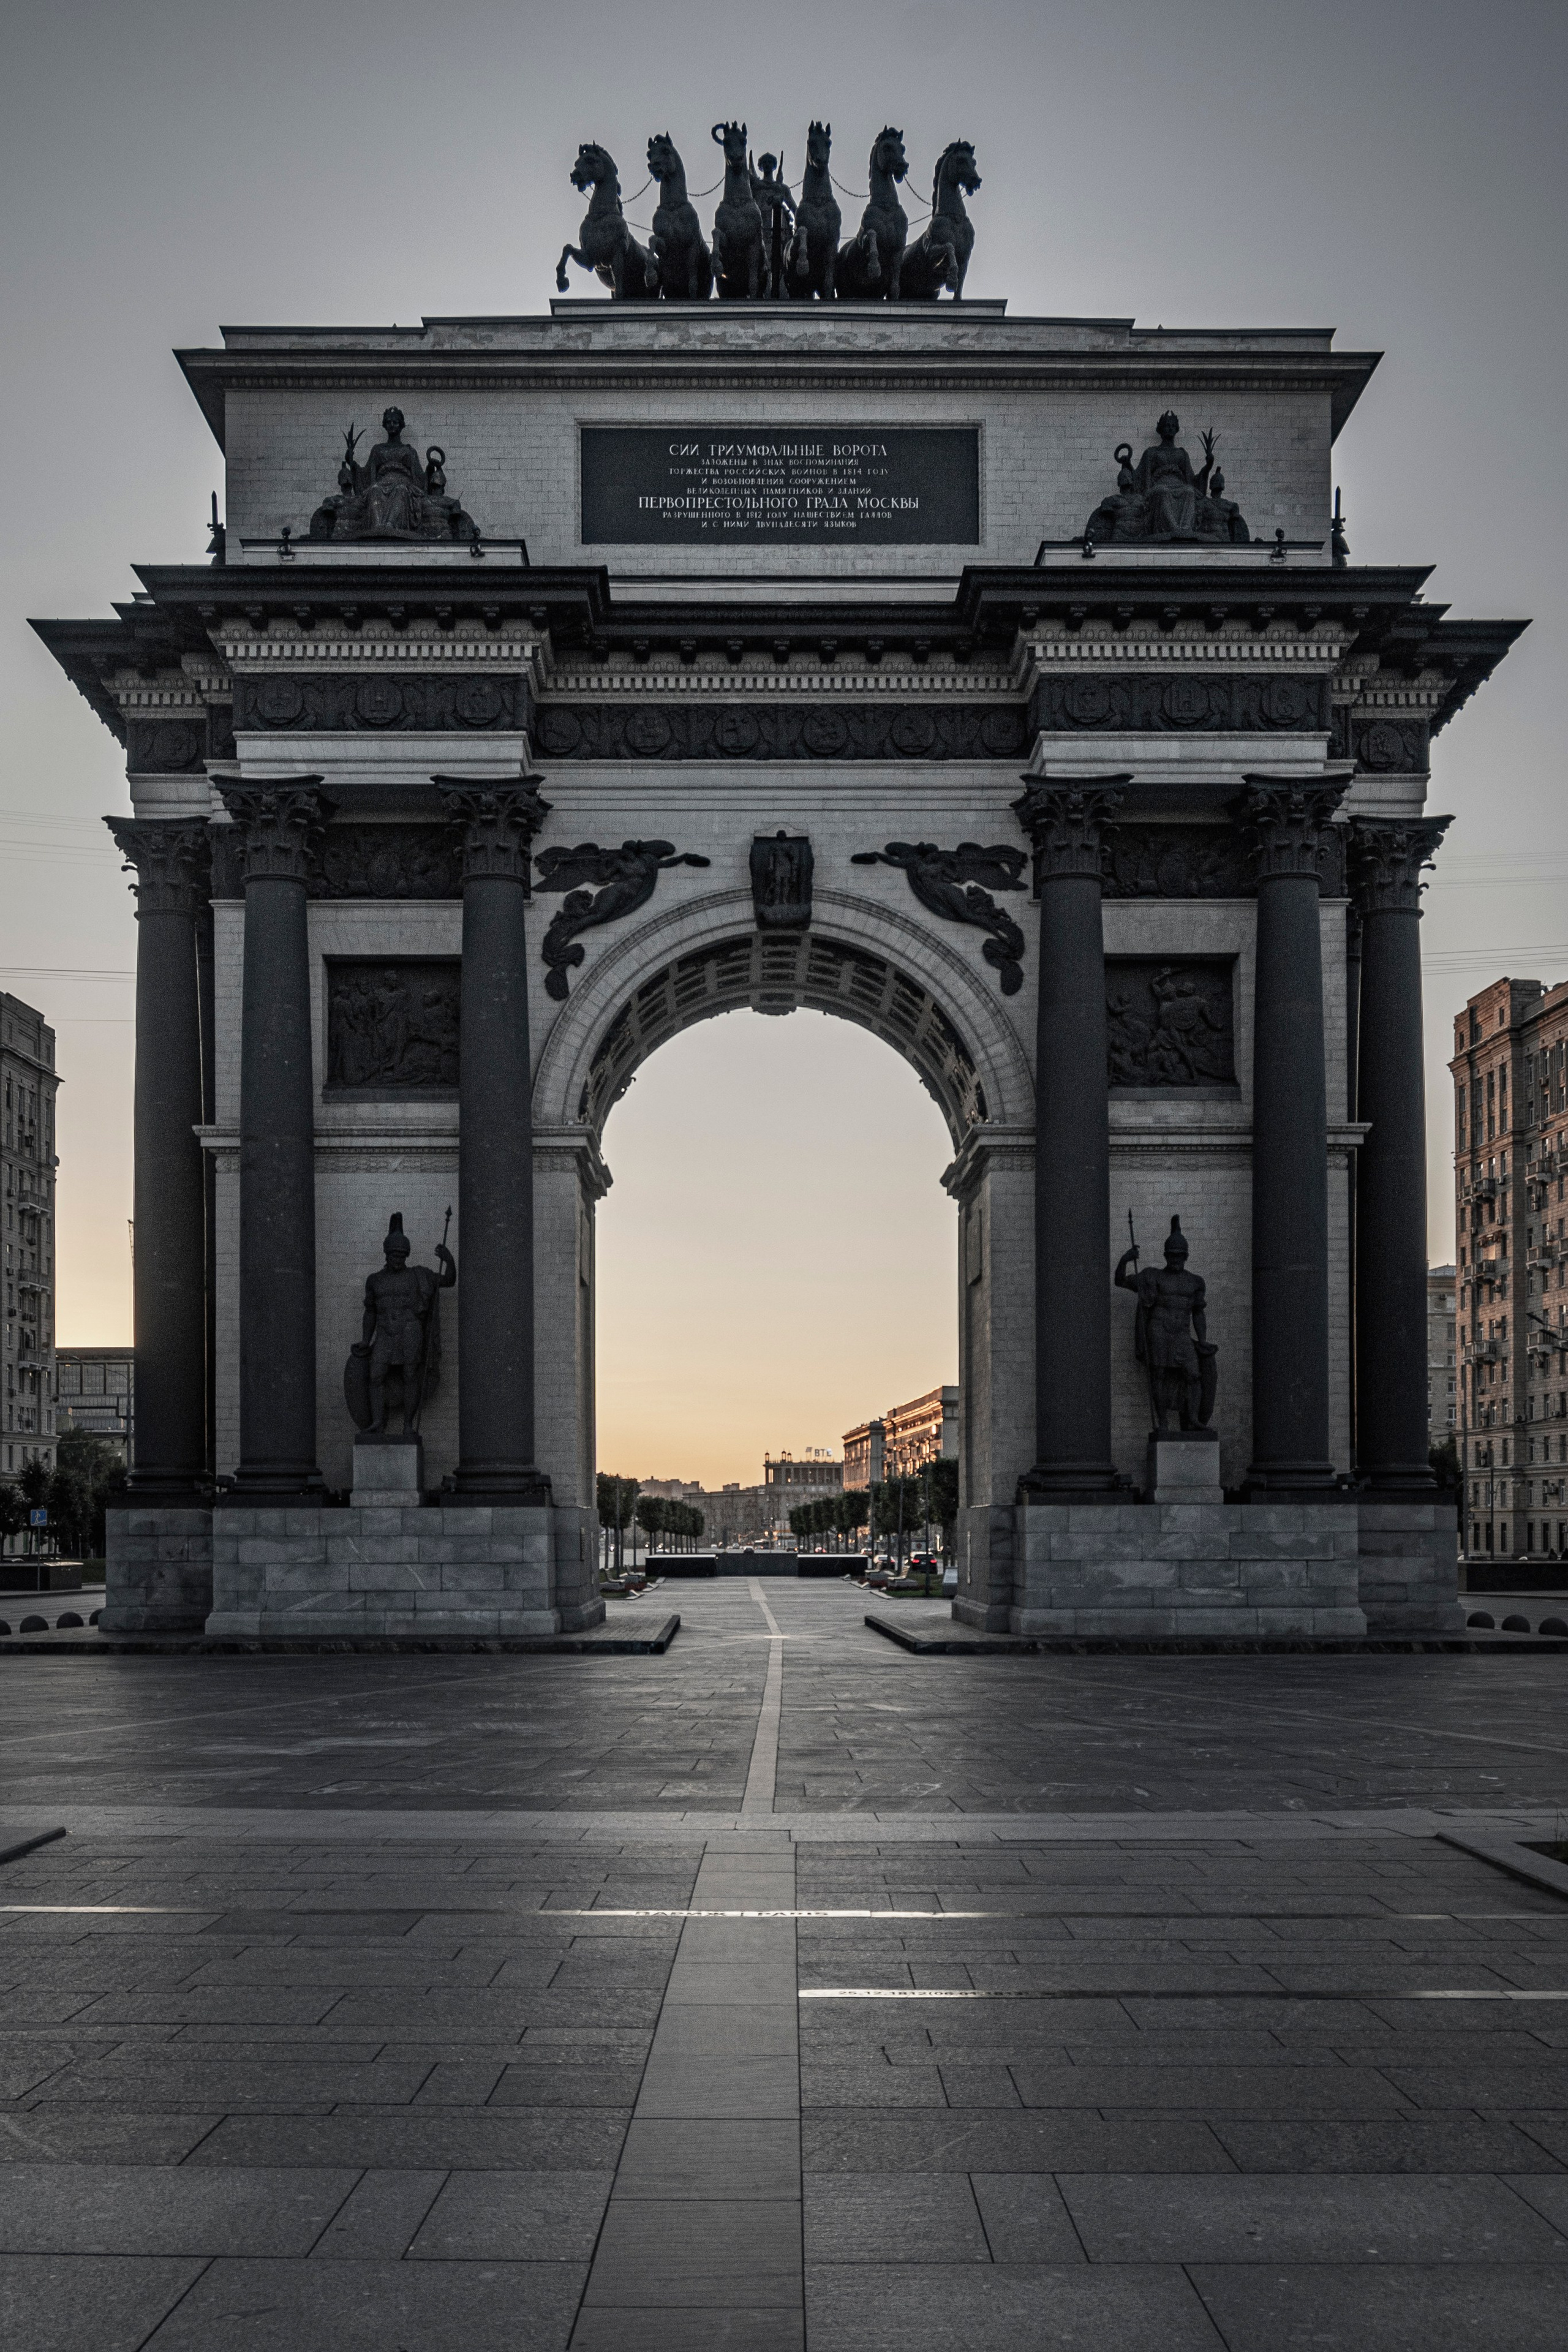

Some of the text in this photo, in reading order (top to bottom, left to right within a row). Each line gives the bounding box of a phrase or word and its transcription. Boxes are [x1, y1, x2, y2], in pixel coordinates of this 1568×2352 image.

[669, 444, 888, 456] СИИ ТРИУМФАЛЬНЫЕ ВОРОТА
[638, 497, 919, 509] ПЕРВОПРЕСТОЛЬНОГО ГРАДА МОСКВЫ
